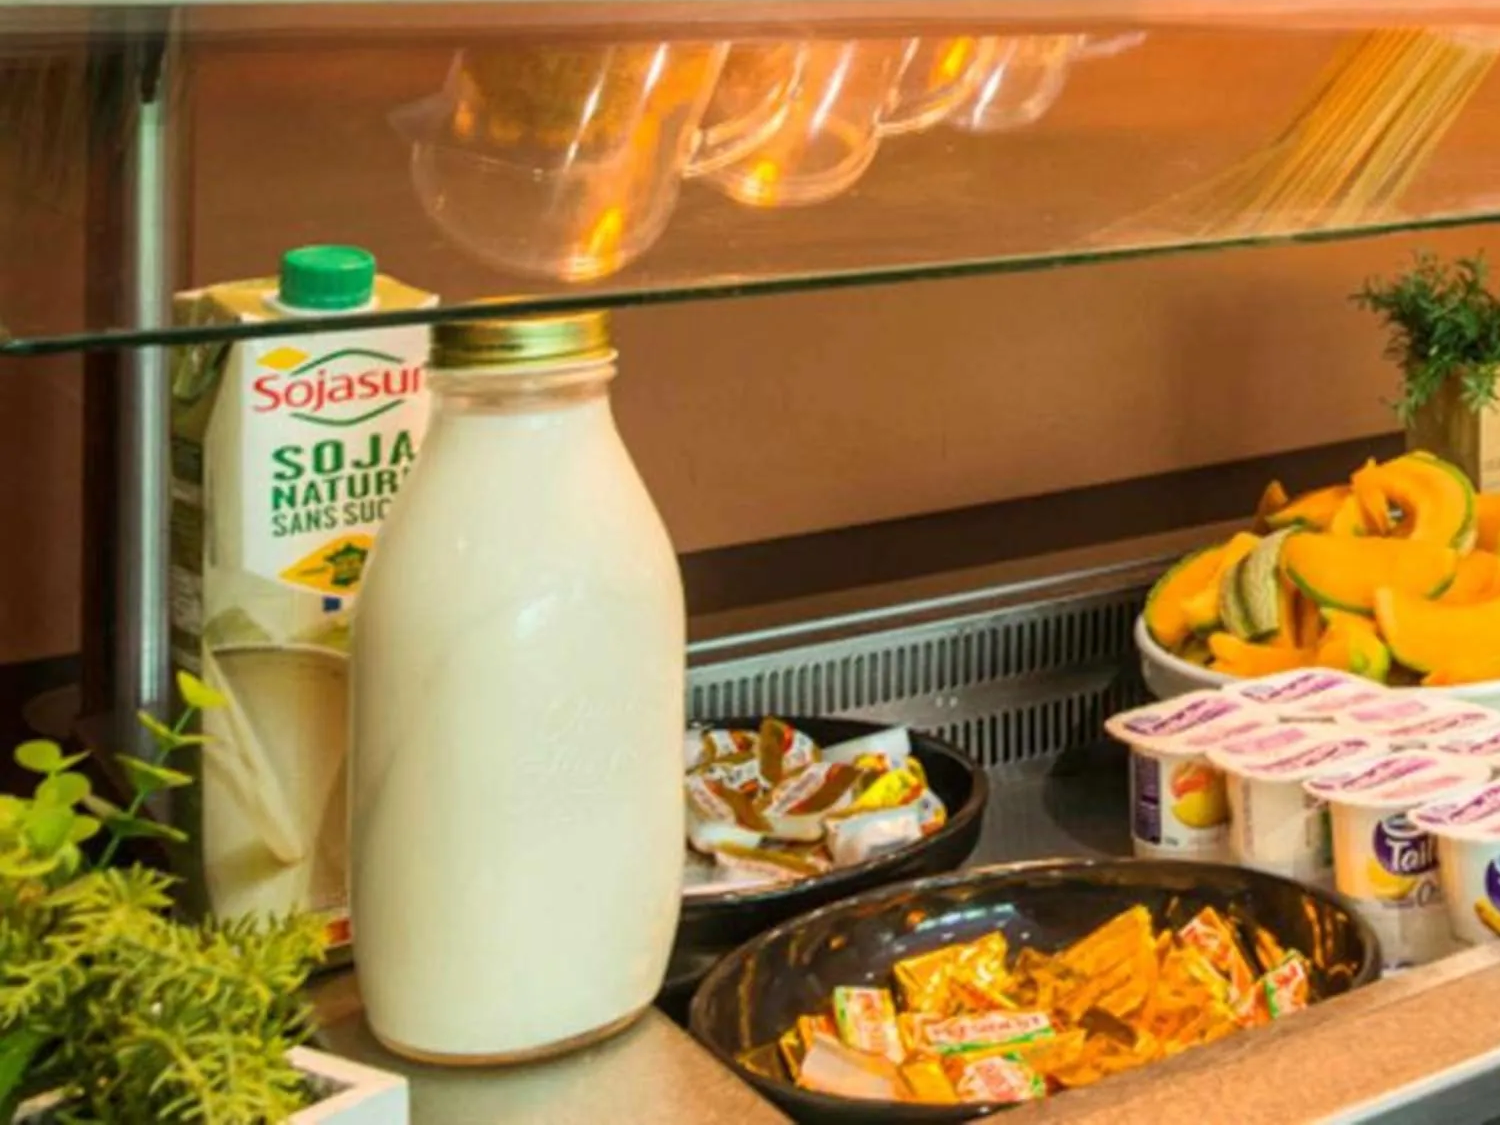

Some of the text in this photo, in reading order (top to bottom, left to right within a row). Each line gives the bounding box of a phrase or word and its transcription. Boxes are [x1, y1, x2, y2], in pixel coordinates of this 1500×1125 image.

[272, 431, 415, 480] SOJA
[271, 466, 412, 511] NATUR
[272, 504, 338, 538] SANS
